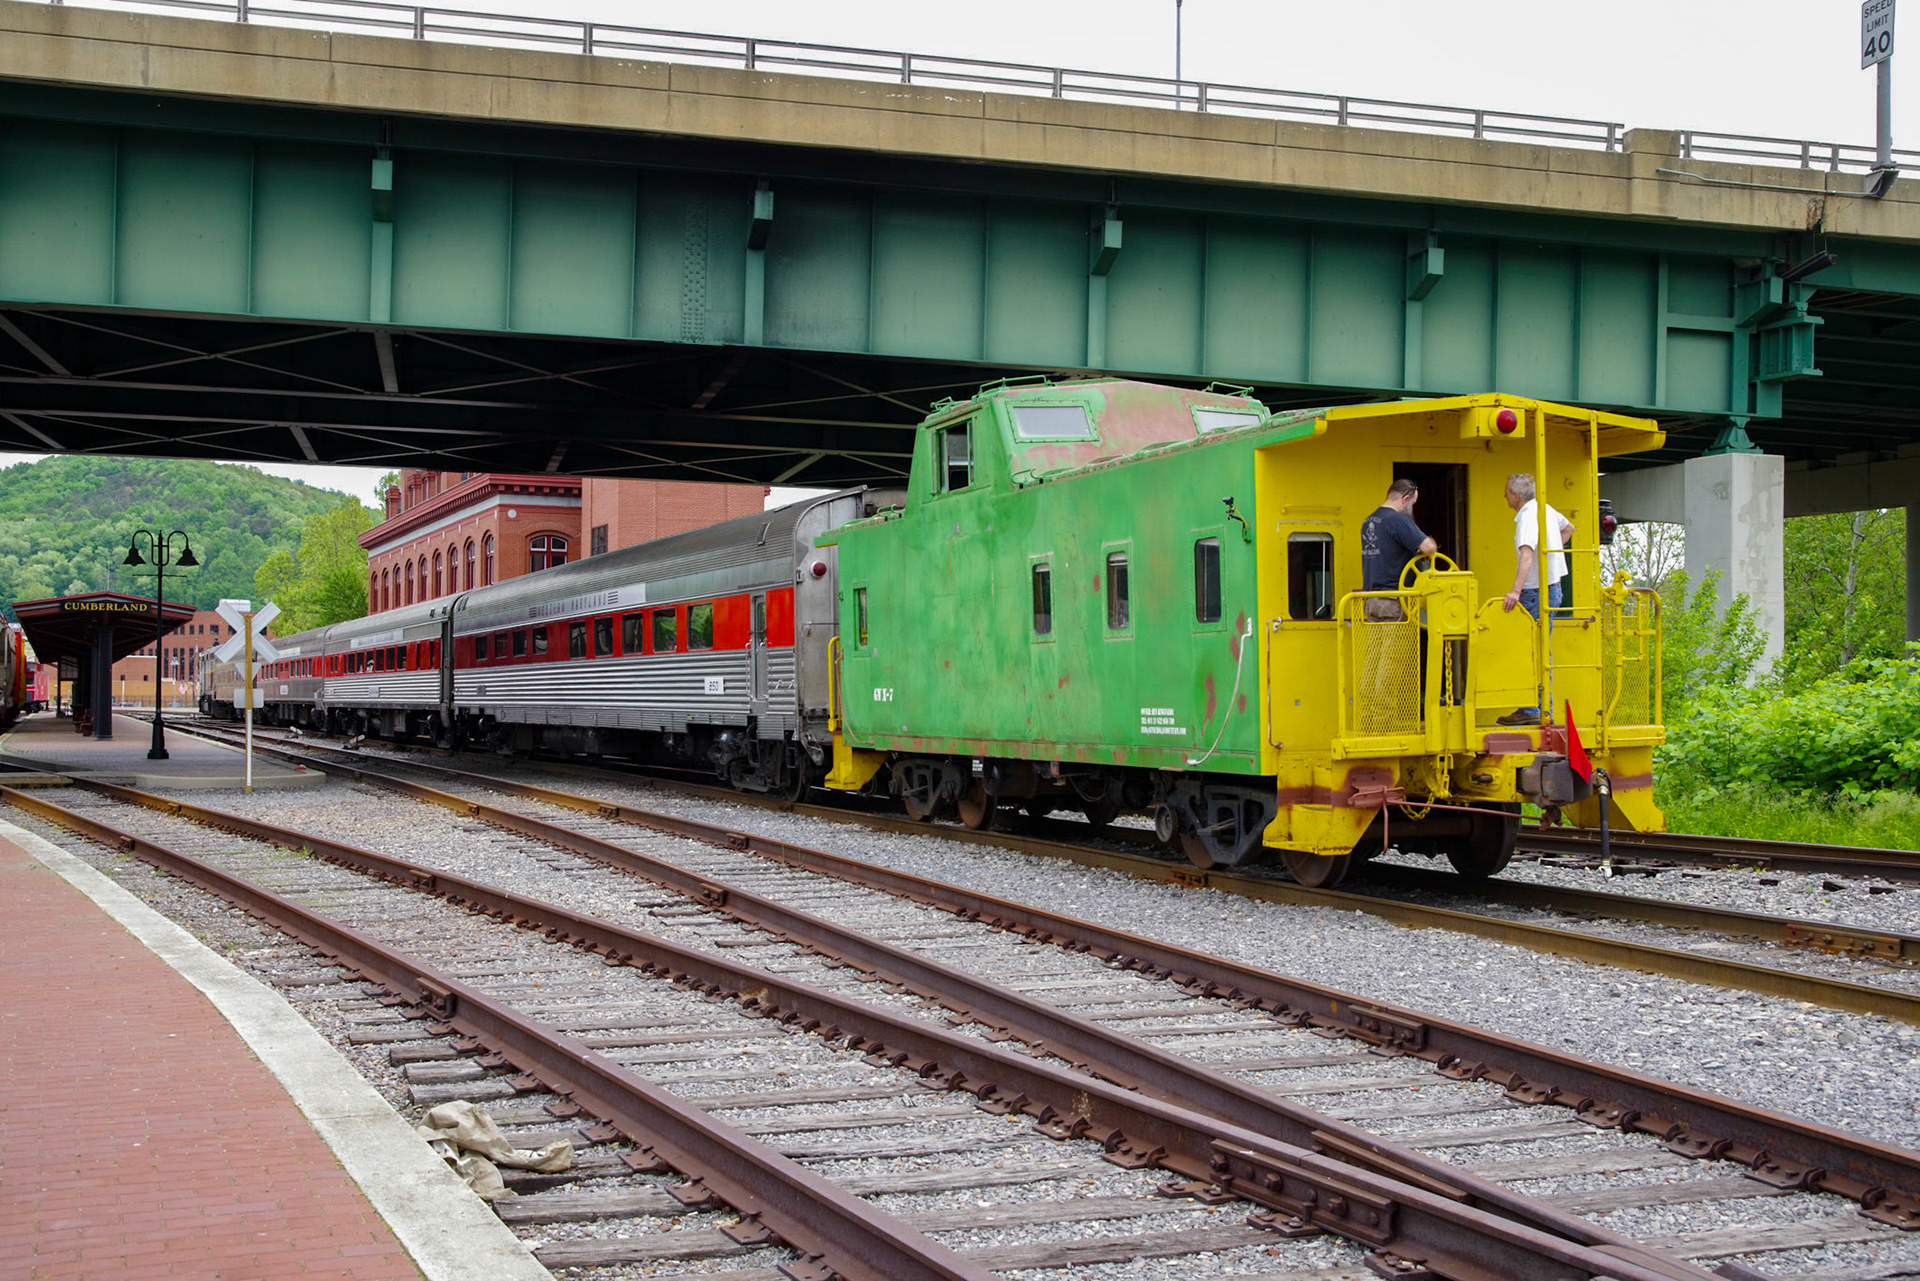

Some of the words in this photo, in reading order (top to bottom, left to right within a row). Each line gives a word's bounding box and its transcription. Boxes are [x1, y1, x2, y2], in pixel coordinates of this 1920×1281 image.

[1864, 0, 1892, 18] SPEED
[1867, 13, 1889, 33] LIMIT
[1864, 30, 1890, 58] 40
[64, 602, 148, 612] CUMBERLAND
